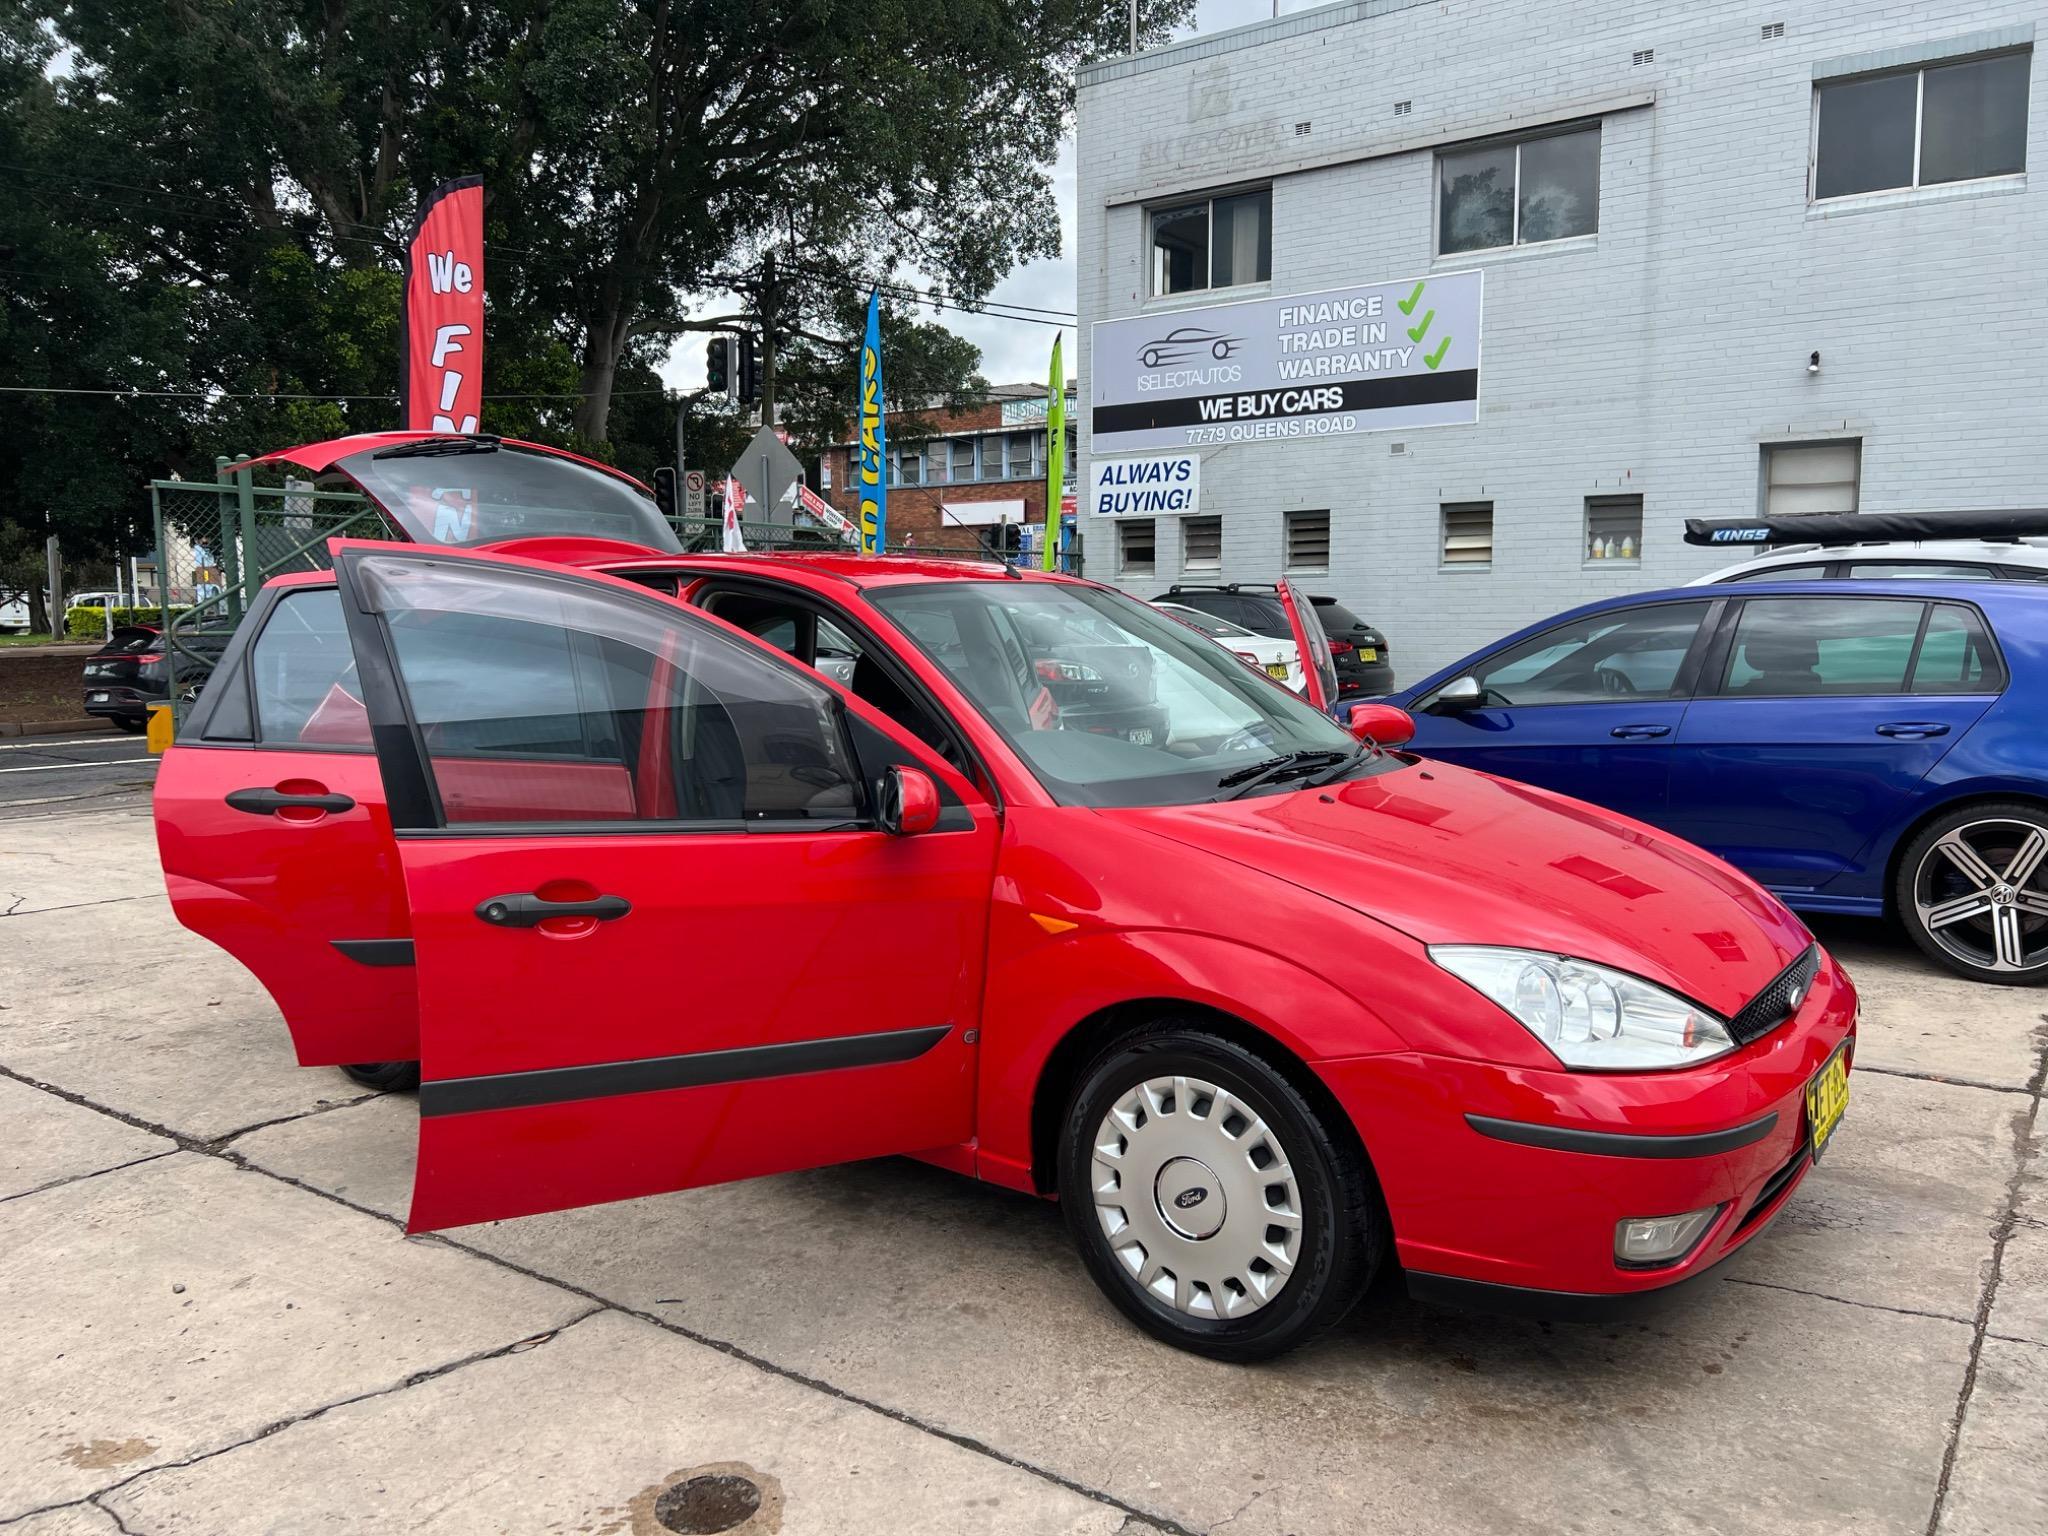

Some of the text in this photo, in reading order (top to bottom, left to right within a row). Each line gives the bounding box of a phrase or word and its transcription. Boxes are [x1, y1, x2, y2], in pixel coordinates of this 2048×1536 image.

[427, 250, 473, 295] We
[1278, 295, 1383, 329] FINANCE
[1278, 322, 1387, 355] TRADE IN
[1277, 346, 1415, 381] WARRANTY
[1199, 386, 1344, 421] WE BUY CARS
[1185, 415, 1357, 445] 77-79 QUEENS ROAD
[1099, 459, 1191, 487] ALWAYS
[1098, 488, 1192, 515] BUYING!
[1710, 527, 1771, 542] KINGS
[1180, 1190, 1204, 1208] Ford
